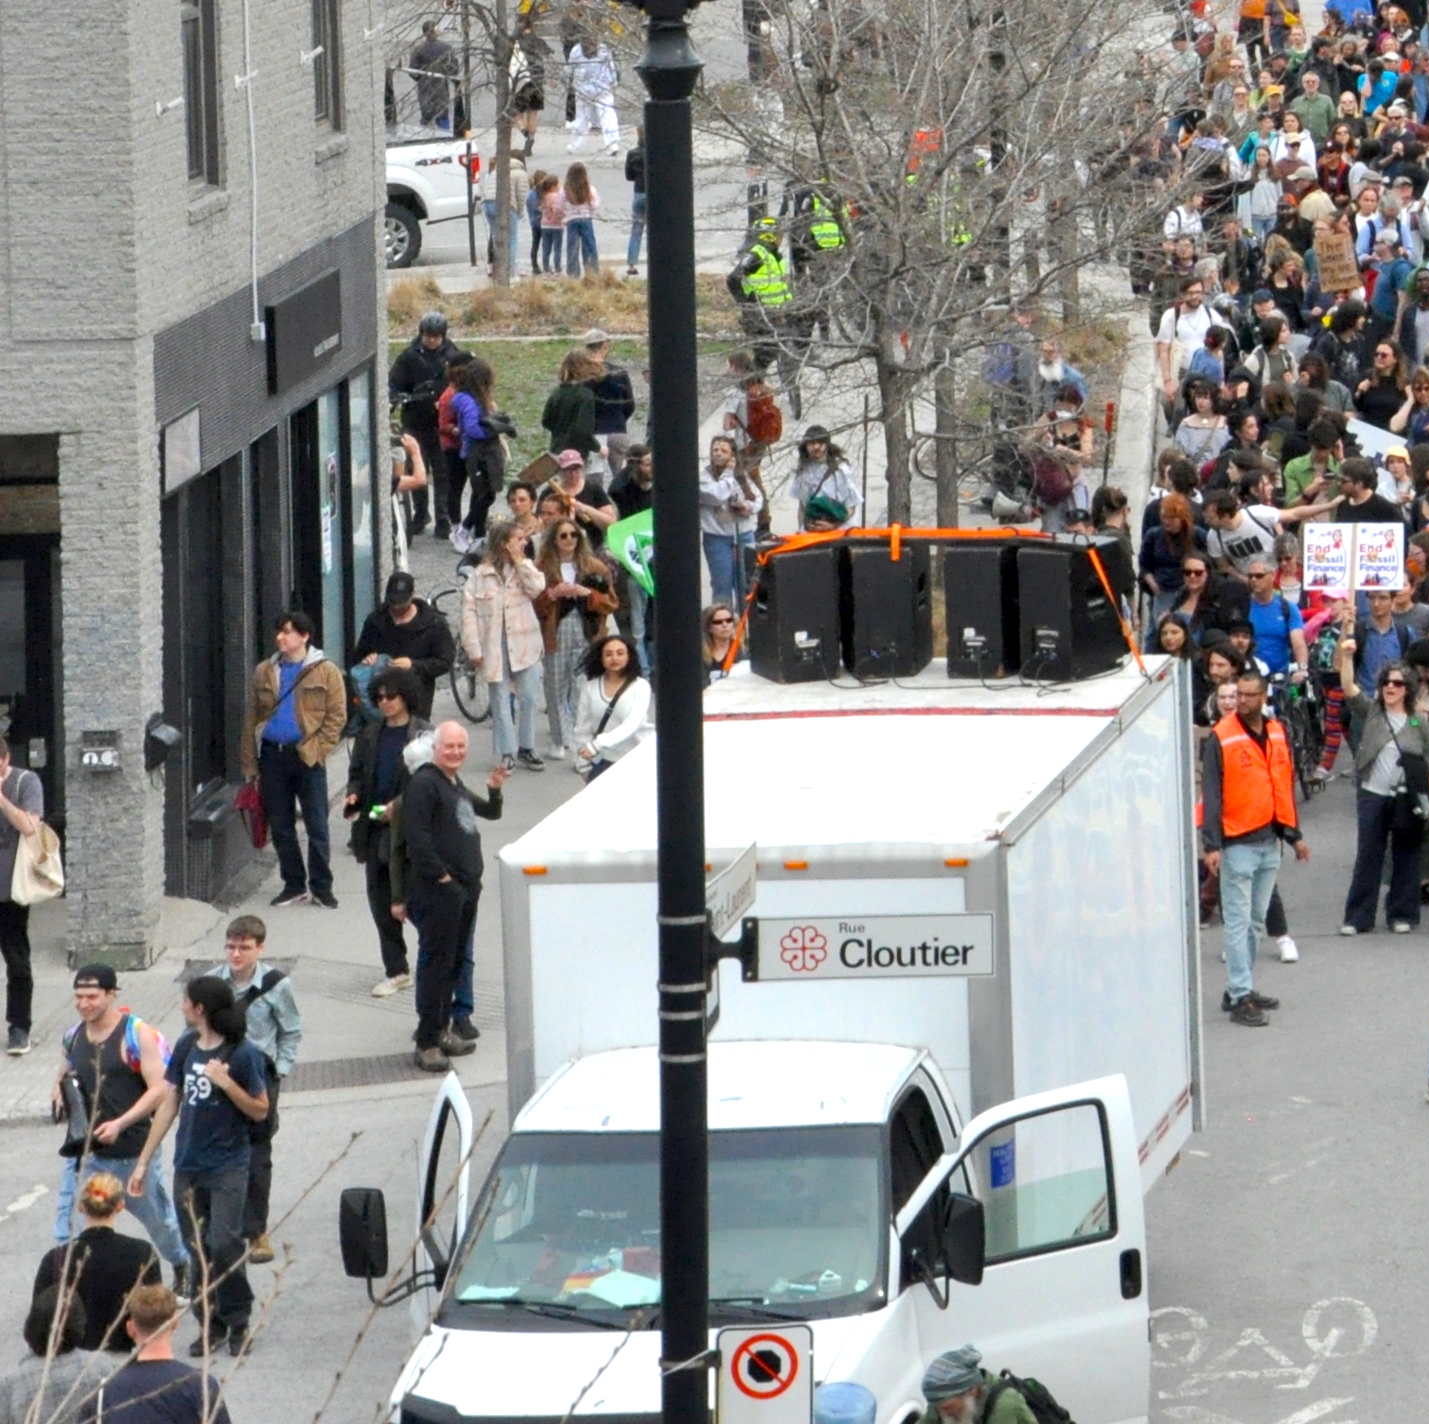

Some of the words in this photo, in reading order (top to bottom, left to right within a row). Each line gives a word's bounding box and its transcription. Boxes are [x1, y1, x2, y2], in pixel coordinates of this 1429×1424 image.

[1306, 543, 1331, 554] End
[1359, 543, 1384, 554] End
[1306, 563, 1346, 572] Finance
[1359, 563, 1398, 572] Finance
[838, 921, 866, 935] Rue
[838, 936, 975, 969] Cloutier
